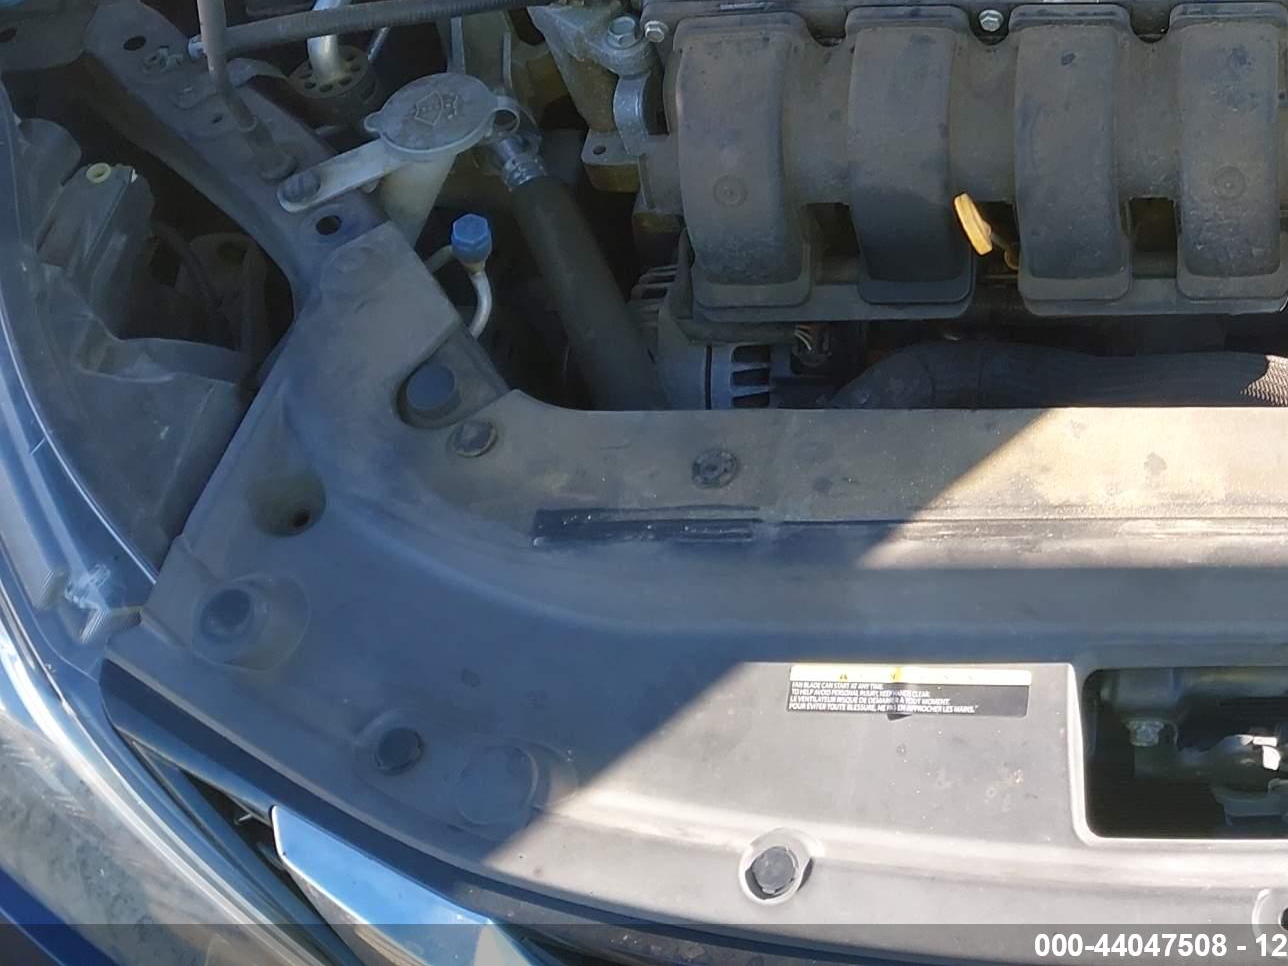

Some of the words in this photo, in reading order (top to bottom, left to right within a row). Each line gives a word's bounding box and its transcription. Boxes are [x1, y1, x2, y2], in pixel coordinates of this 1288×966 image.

[792, 688, 800, 696] TO
[798, 695, 836, 703] VENTILATEUR
[836, 696, 858, 704] RISQUE
[858, 696, 867, 704] DE
[905, 697, 921, 705] TOUT
[789, 702, 806, 710] POUR
[877, 704, 886, 712] NE
[897, 704, 906, 712] EN
[906, 705, 942, 713] APPROCHER
[942, 705, 954, 713] LES
